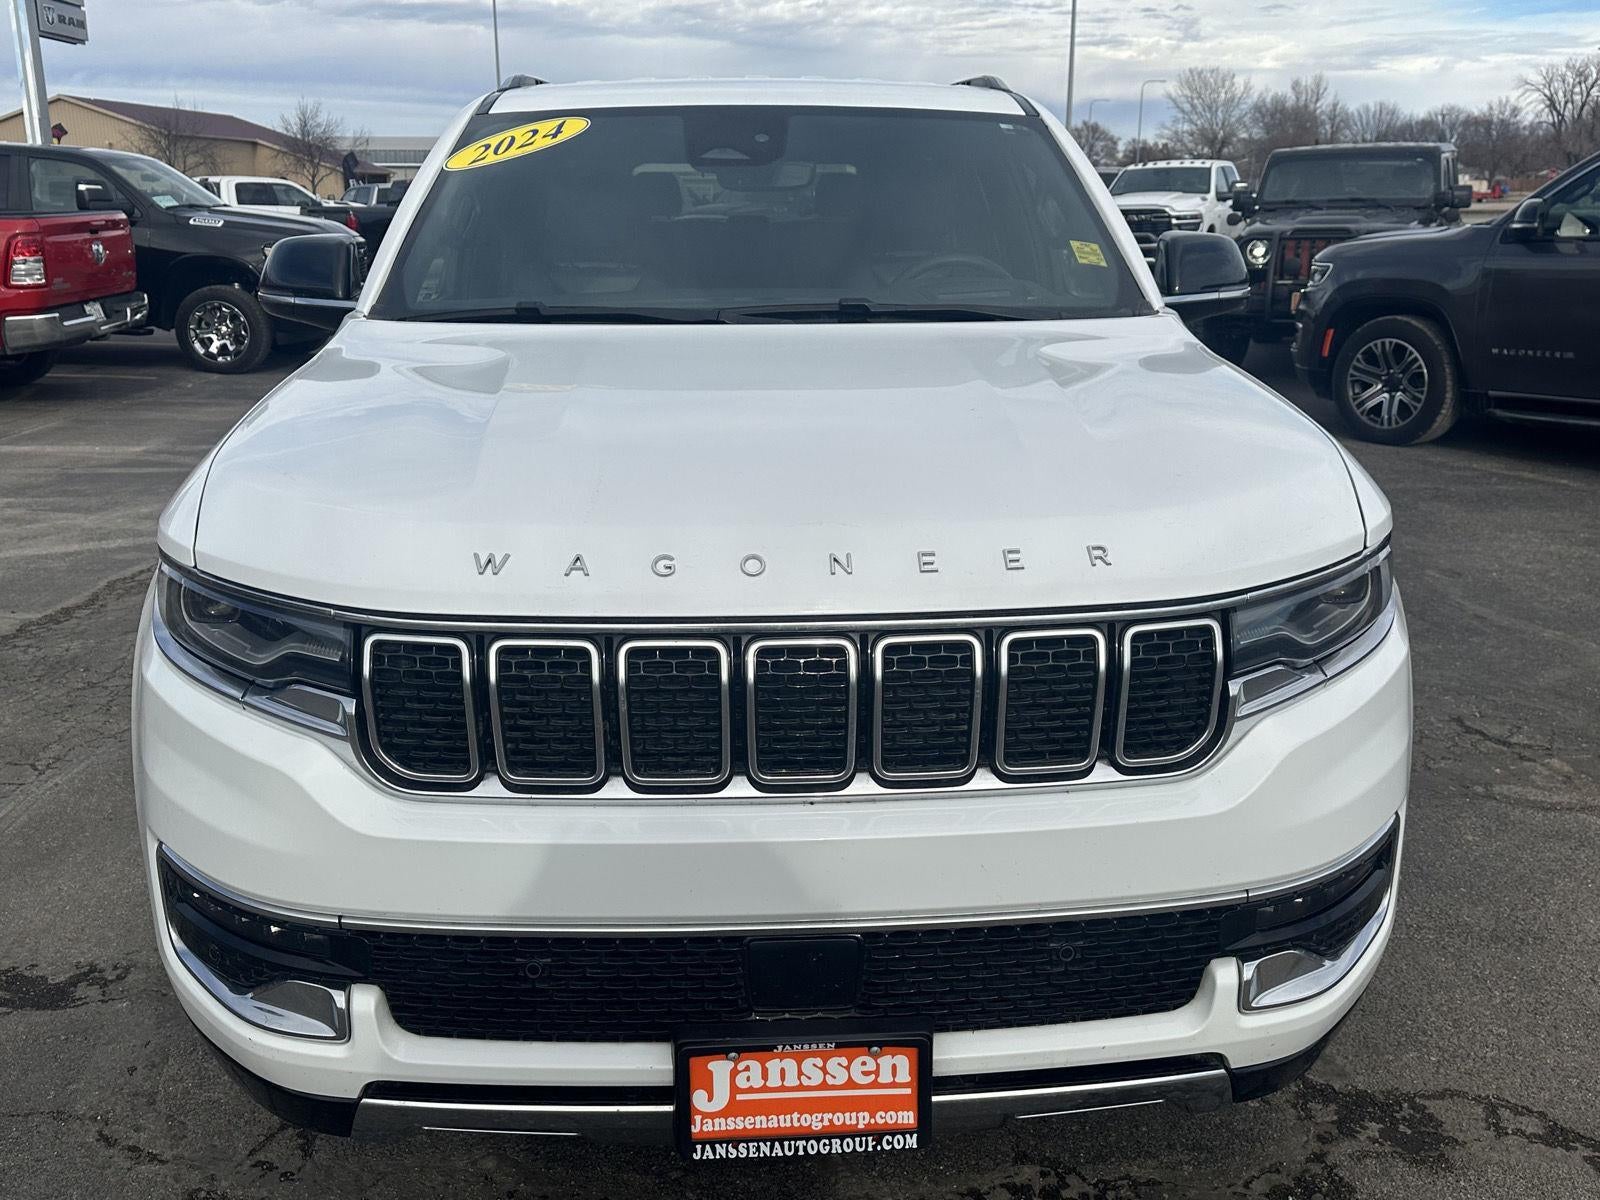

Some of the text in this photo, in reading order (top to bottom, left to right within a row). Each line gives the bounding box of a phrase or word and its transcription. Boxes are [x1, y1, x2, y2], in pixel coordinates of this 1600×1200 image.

[57, 14, 86, 30] RAM
[467, 119, 567, 166] 2024
[473, 543, 1113, 578] WAGONEER
[773, 1042, 836, 1053] JANSSEN
[692, 1054, 912, 1113] Janssen
[691, 1109, 915, 1134] Janssenautogroup.com
